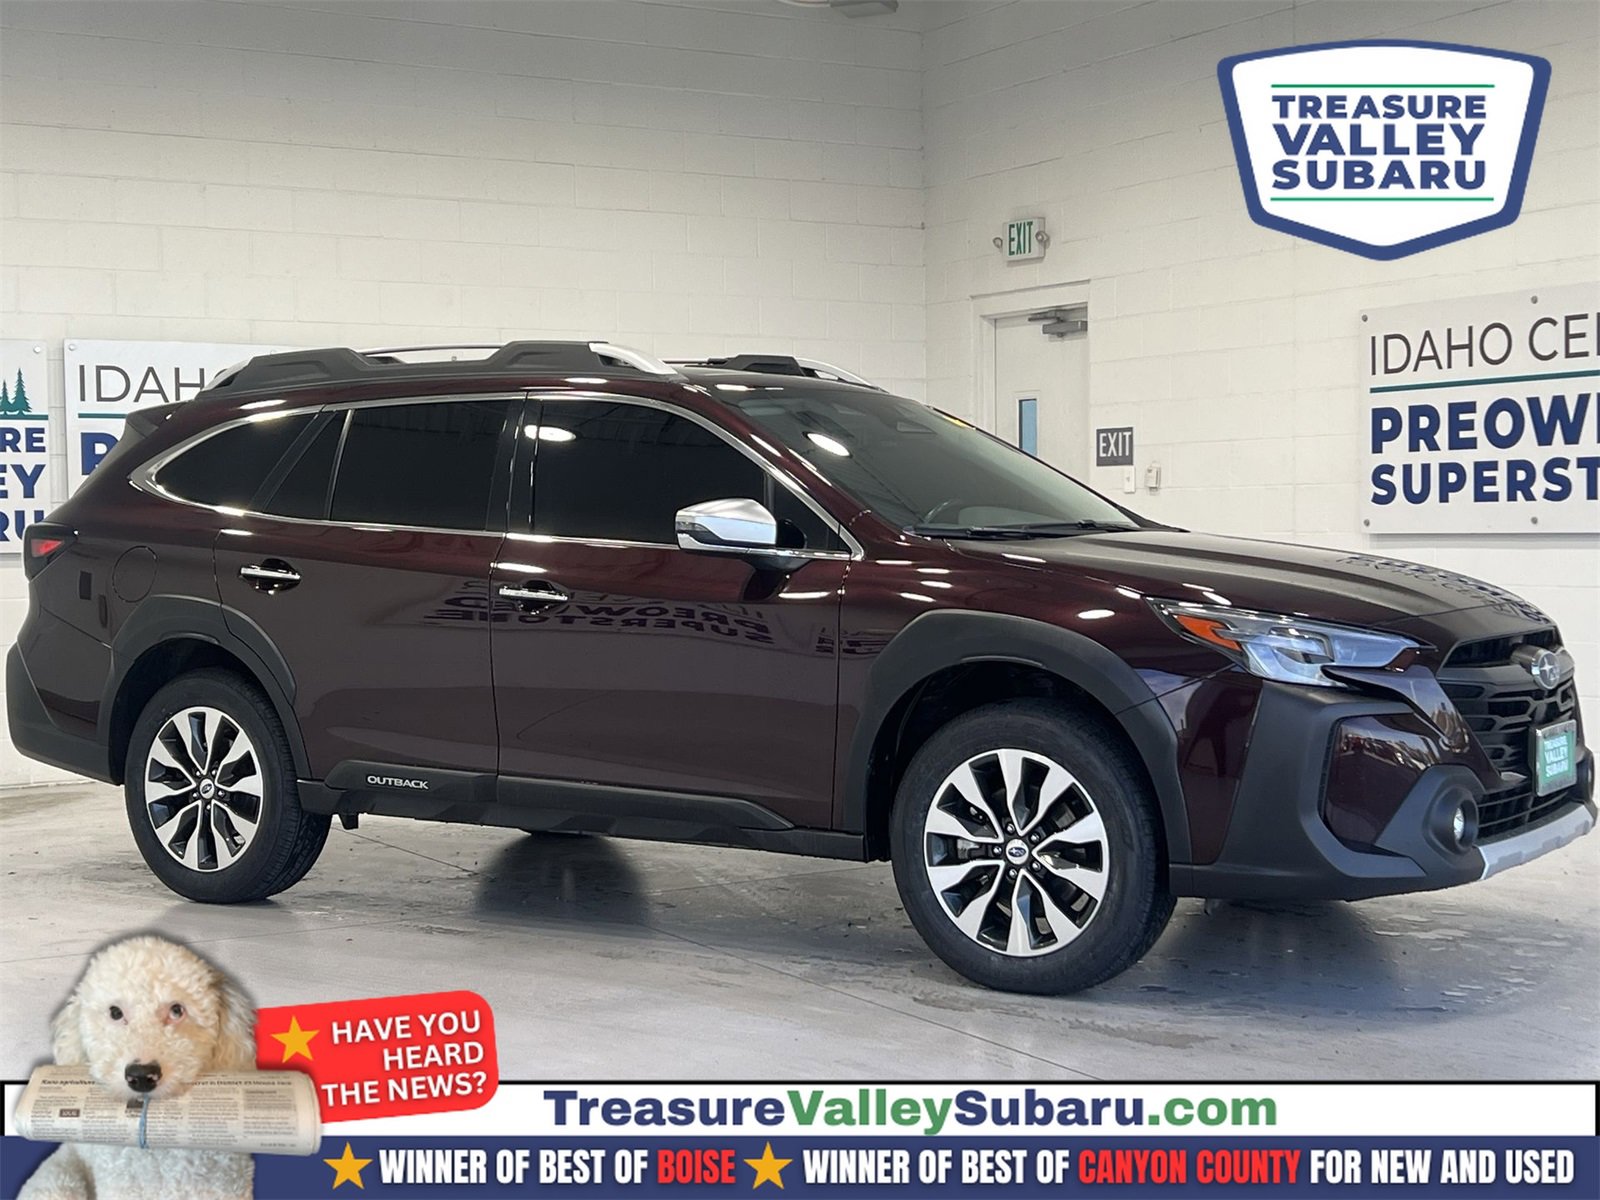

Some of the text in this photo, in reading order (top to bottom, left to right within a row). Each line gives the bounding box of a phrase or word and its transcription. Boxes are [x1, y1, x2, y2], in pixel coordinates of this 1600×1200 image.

[1008, 221, 1033, 256] EXIT
[1371, 312, 1600, 376] IDAHO CE
[78, 365, 228, 403] IDAH
[1371, 392, 1600, 454] PREOW
[1099, 431, 1132, 457] EXIT
[1371, 456, 1600, 505] SUPERST
[367, 775, 429, 790] OUTBACK
